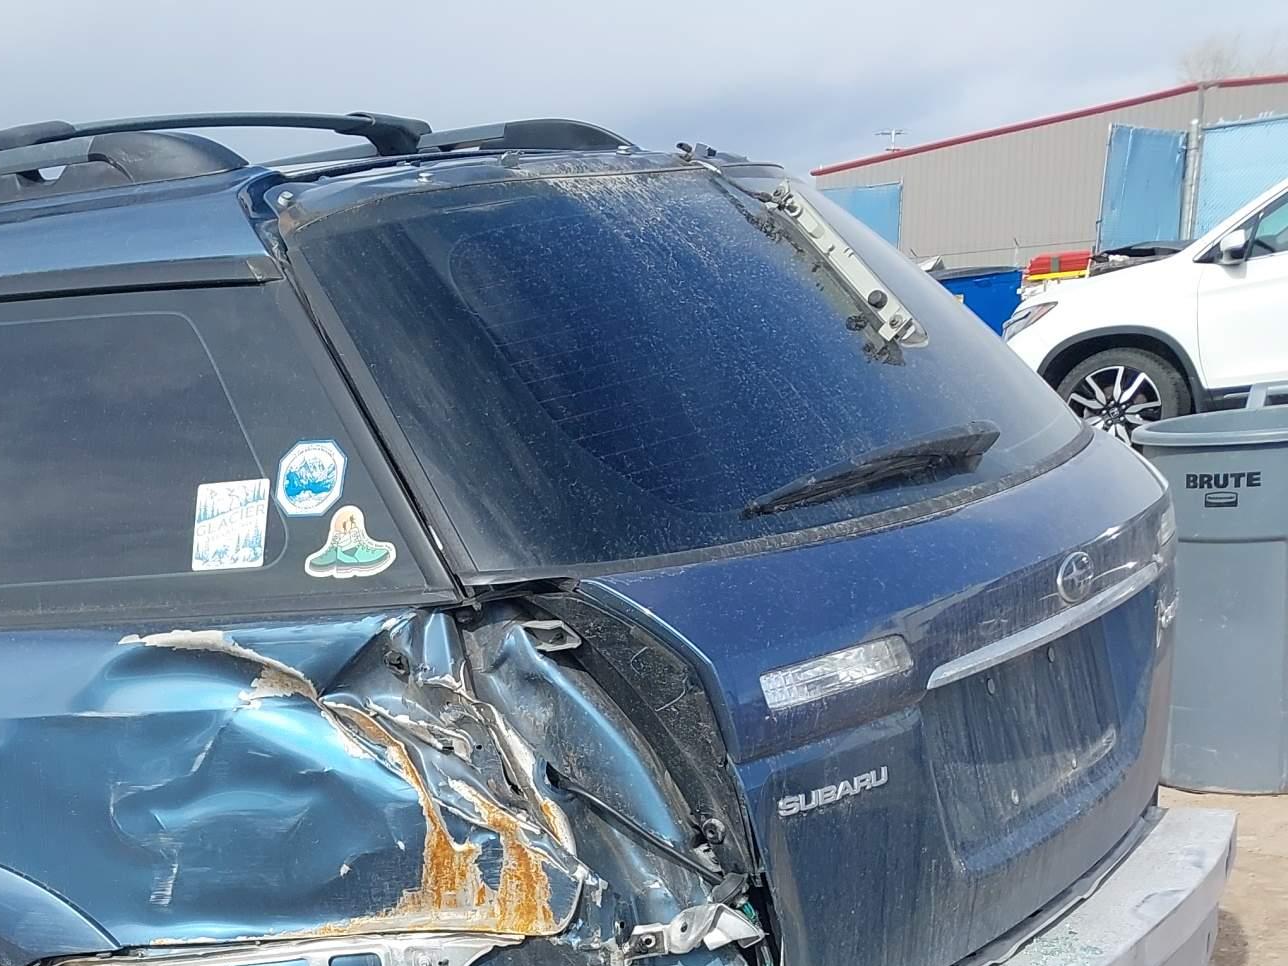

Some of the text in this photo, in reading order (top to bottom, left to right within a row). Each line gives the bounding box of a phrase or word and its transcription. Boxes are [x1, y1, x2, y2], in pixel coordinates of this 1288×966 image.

[1185, 471, 1262, 490] BRUTE
[195, 503, 266, 537] GLACIER
[777, 765, 889, 817] SUBARU
